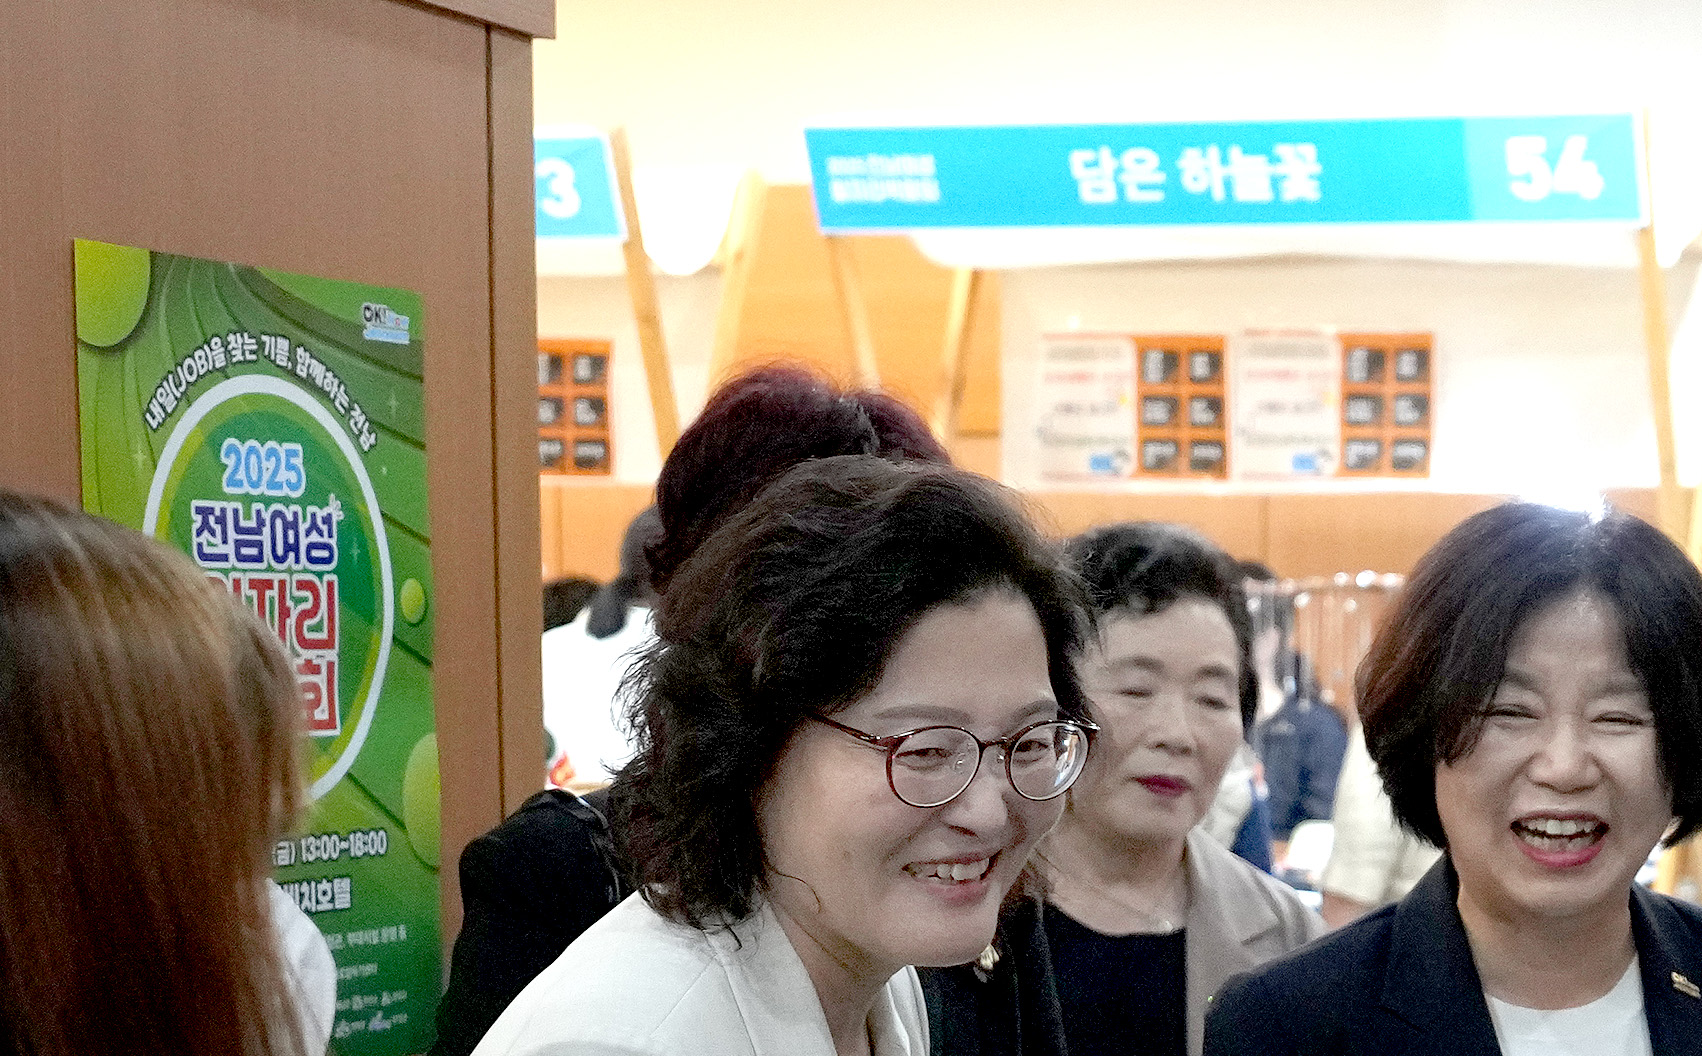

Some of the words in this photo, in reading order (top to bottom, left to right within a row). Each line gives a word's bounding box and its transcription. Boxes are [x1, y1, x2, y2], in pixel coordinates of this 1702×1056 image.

[1069, 146, 1167, 204] 담은
[1504, 135, 1604, 201] 54
[144, 336, 227, 430] 내일(JOB)을
[226, 332, 258, 363] 찾는
[295, 346, 350, 415] 함께하는
[349, 403, 378, 451] 전남
[221, 439, 306, 496] 2025
[193, 502, 340, 569] 전남여성
[203, 573, 338, 652] 자리
[301, 829, 387, 863] 13:00~18:00
